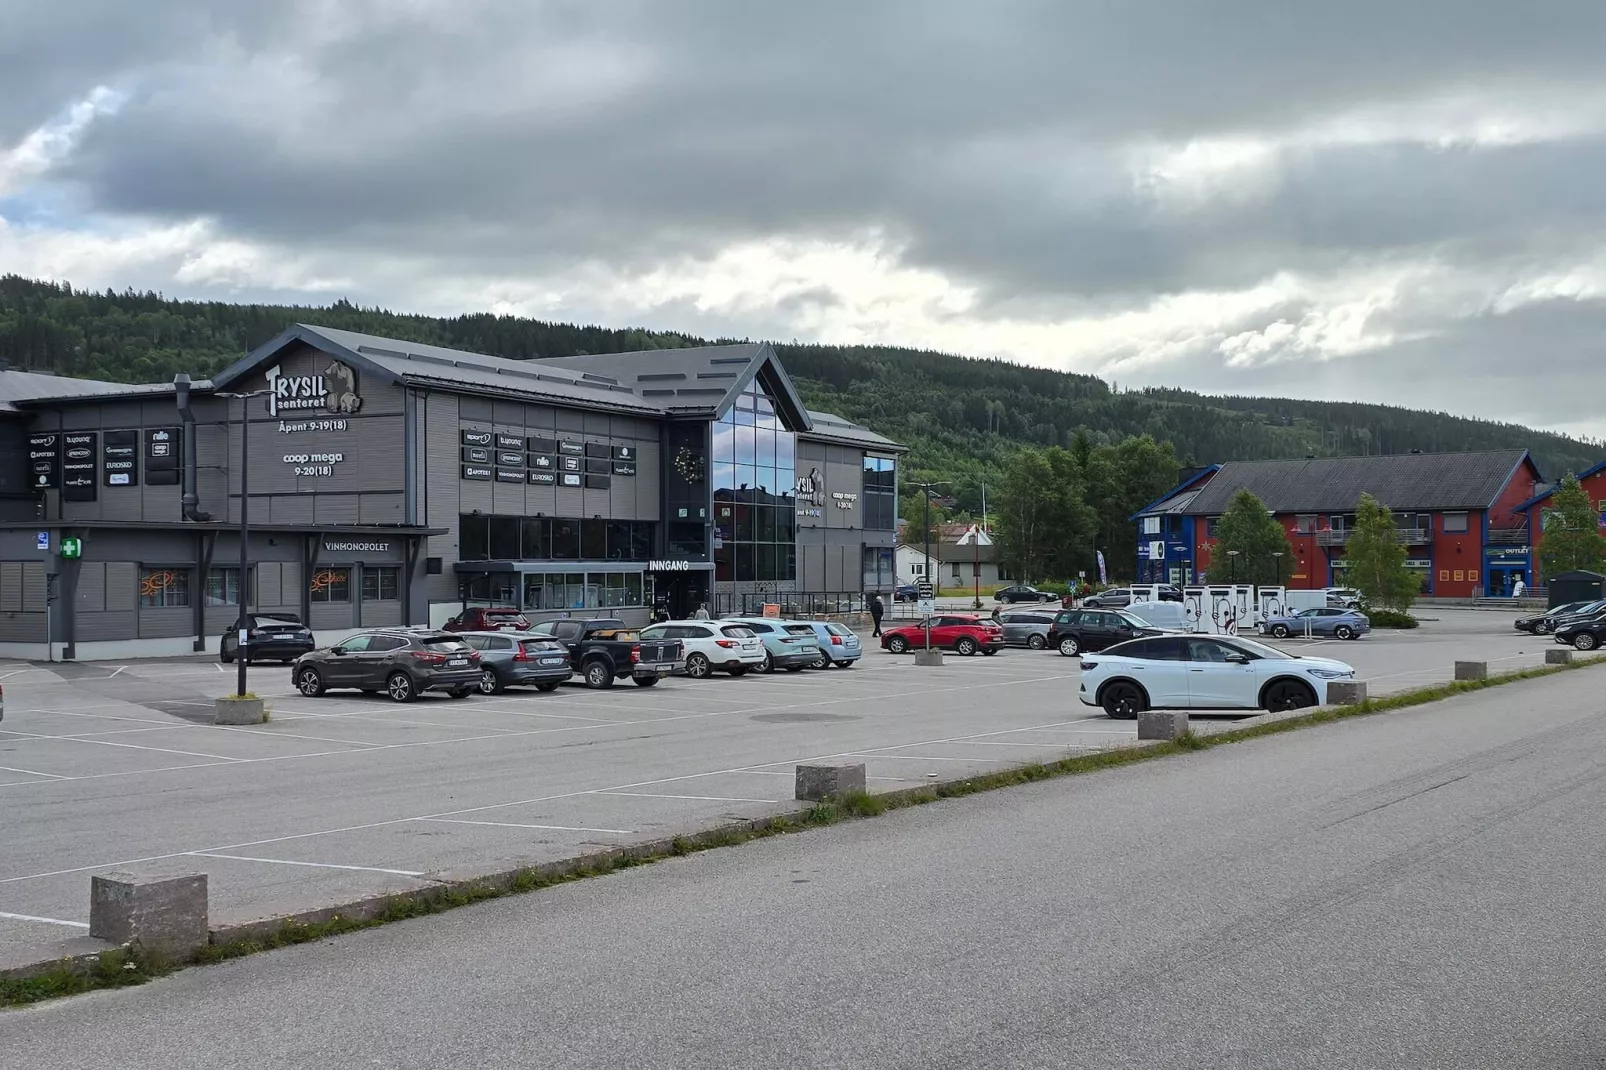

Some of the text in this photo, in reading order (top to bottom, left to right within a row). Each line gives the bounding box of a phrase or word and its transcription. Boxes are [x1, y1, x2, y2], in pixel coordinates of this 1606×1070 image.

[265, 364, 327, 416] TRYSIL
[277, 397, 325, 408] senteret
[278, 420, 347, 433] Åpent 9-19(18)
[283, 453, 343, 464] coop mega
[294, 466, 332, 477] 9-20(18)
[325, 542, 389, 551] VINMONOPOLET
[649, 560, 689, 571] INNGANG
